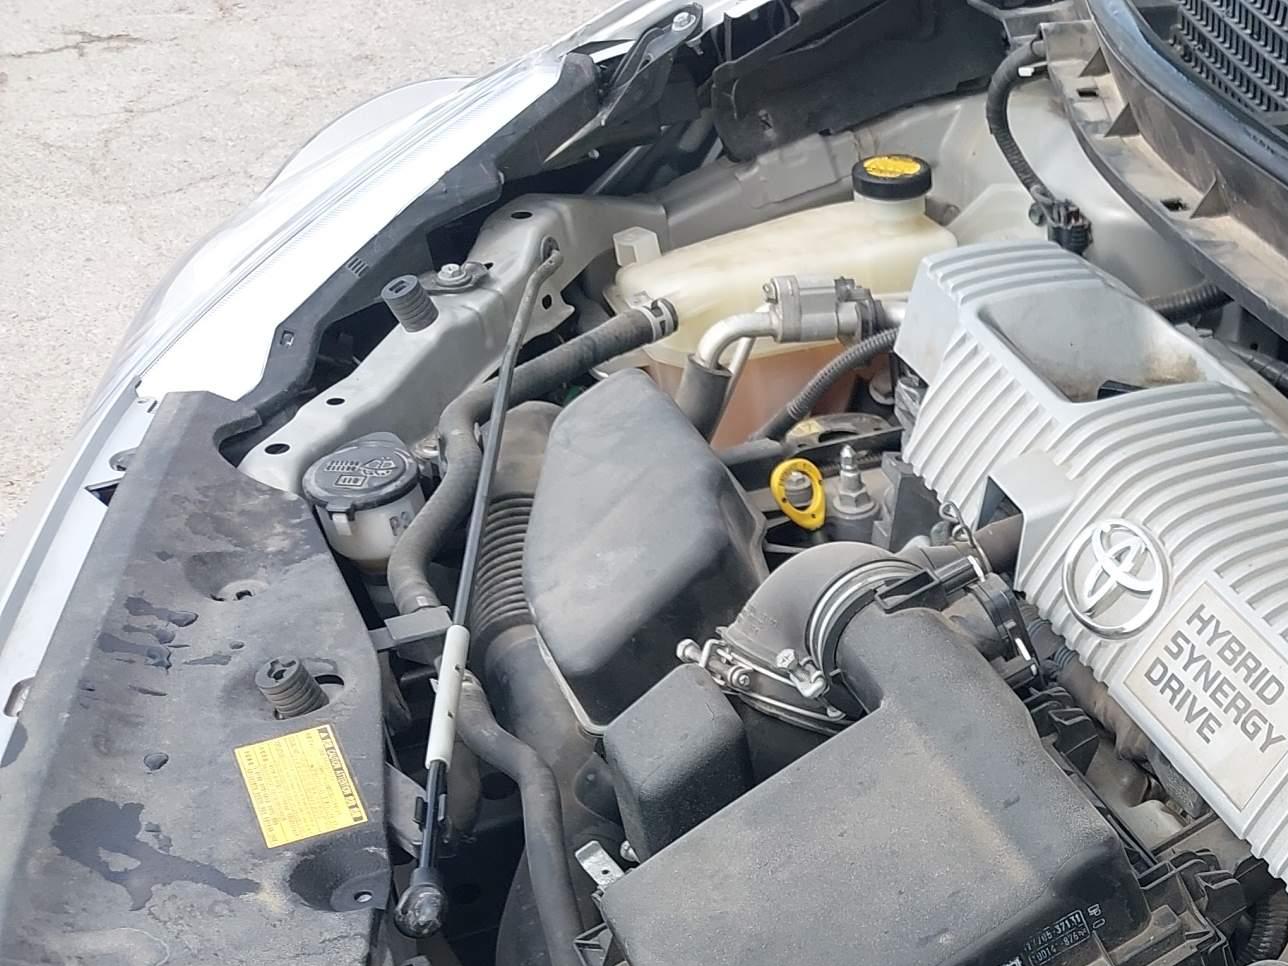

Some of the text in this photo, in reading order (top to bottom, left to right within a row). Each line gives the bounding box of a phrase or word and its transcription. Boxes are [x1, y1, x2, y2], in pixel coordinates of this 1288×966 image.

[1144, 657, 1222, 744] DRIVE
[1164, 630, 1287, 753] SYNERGY
[1186, 604, 1284, 706] HYBRID
